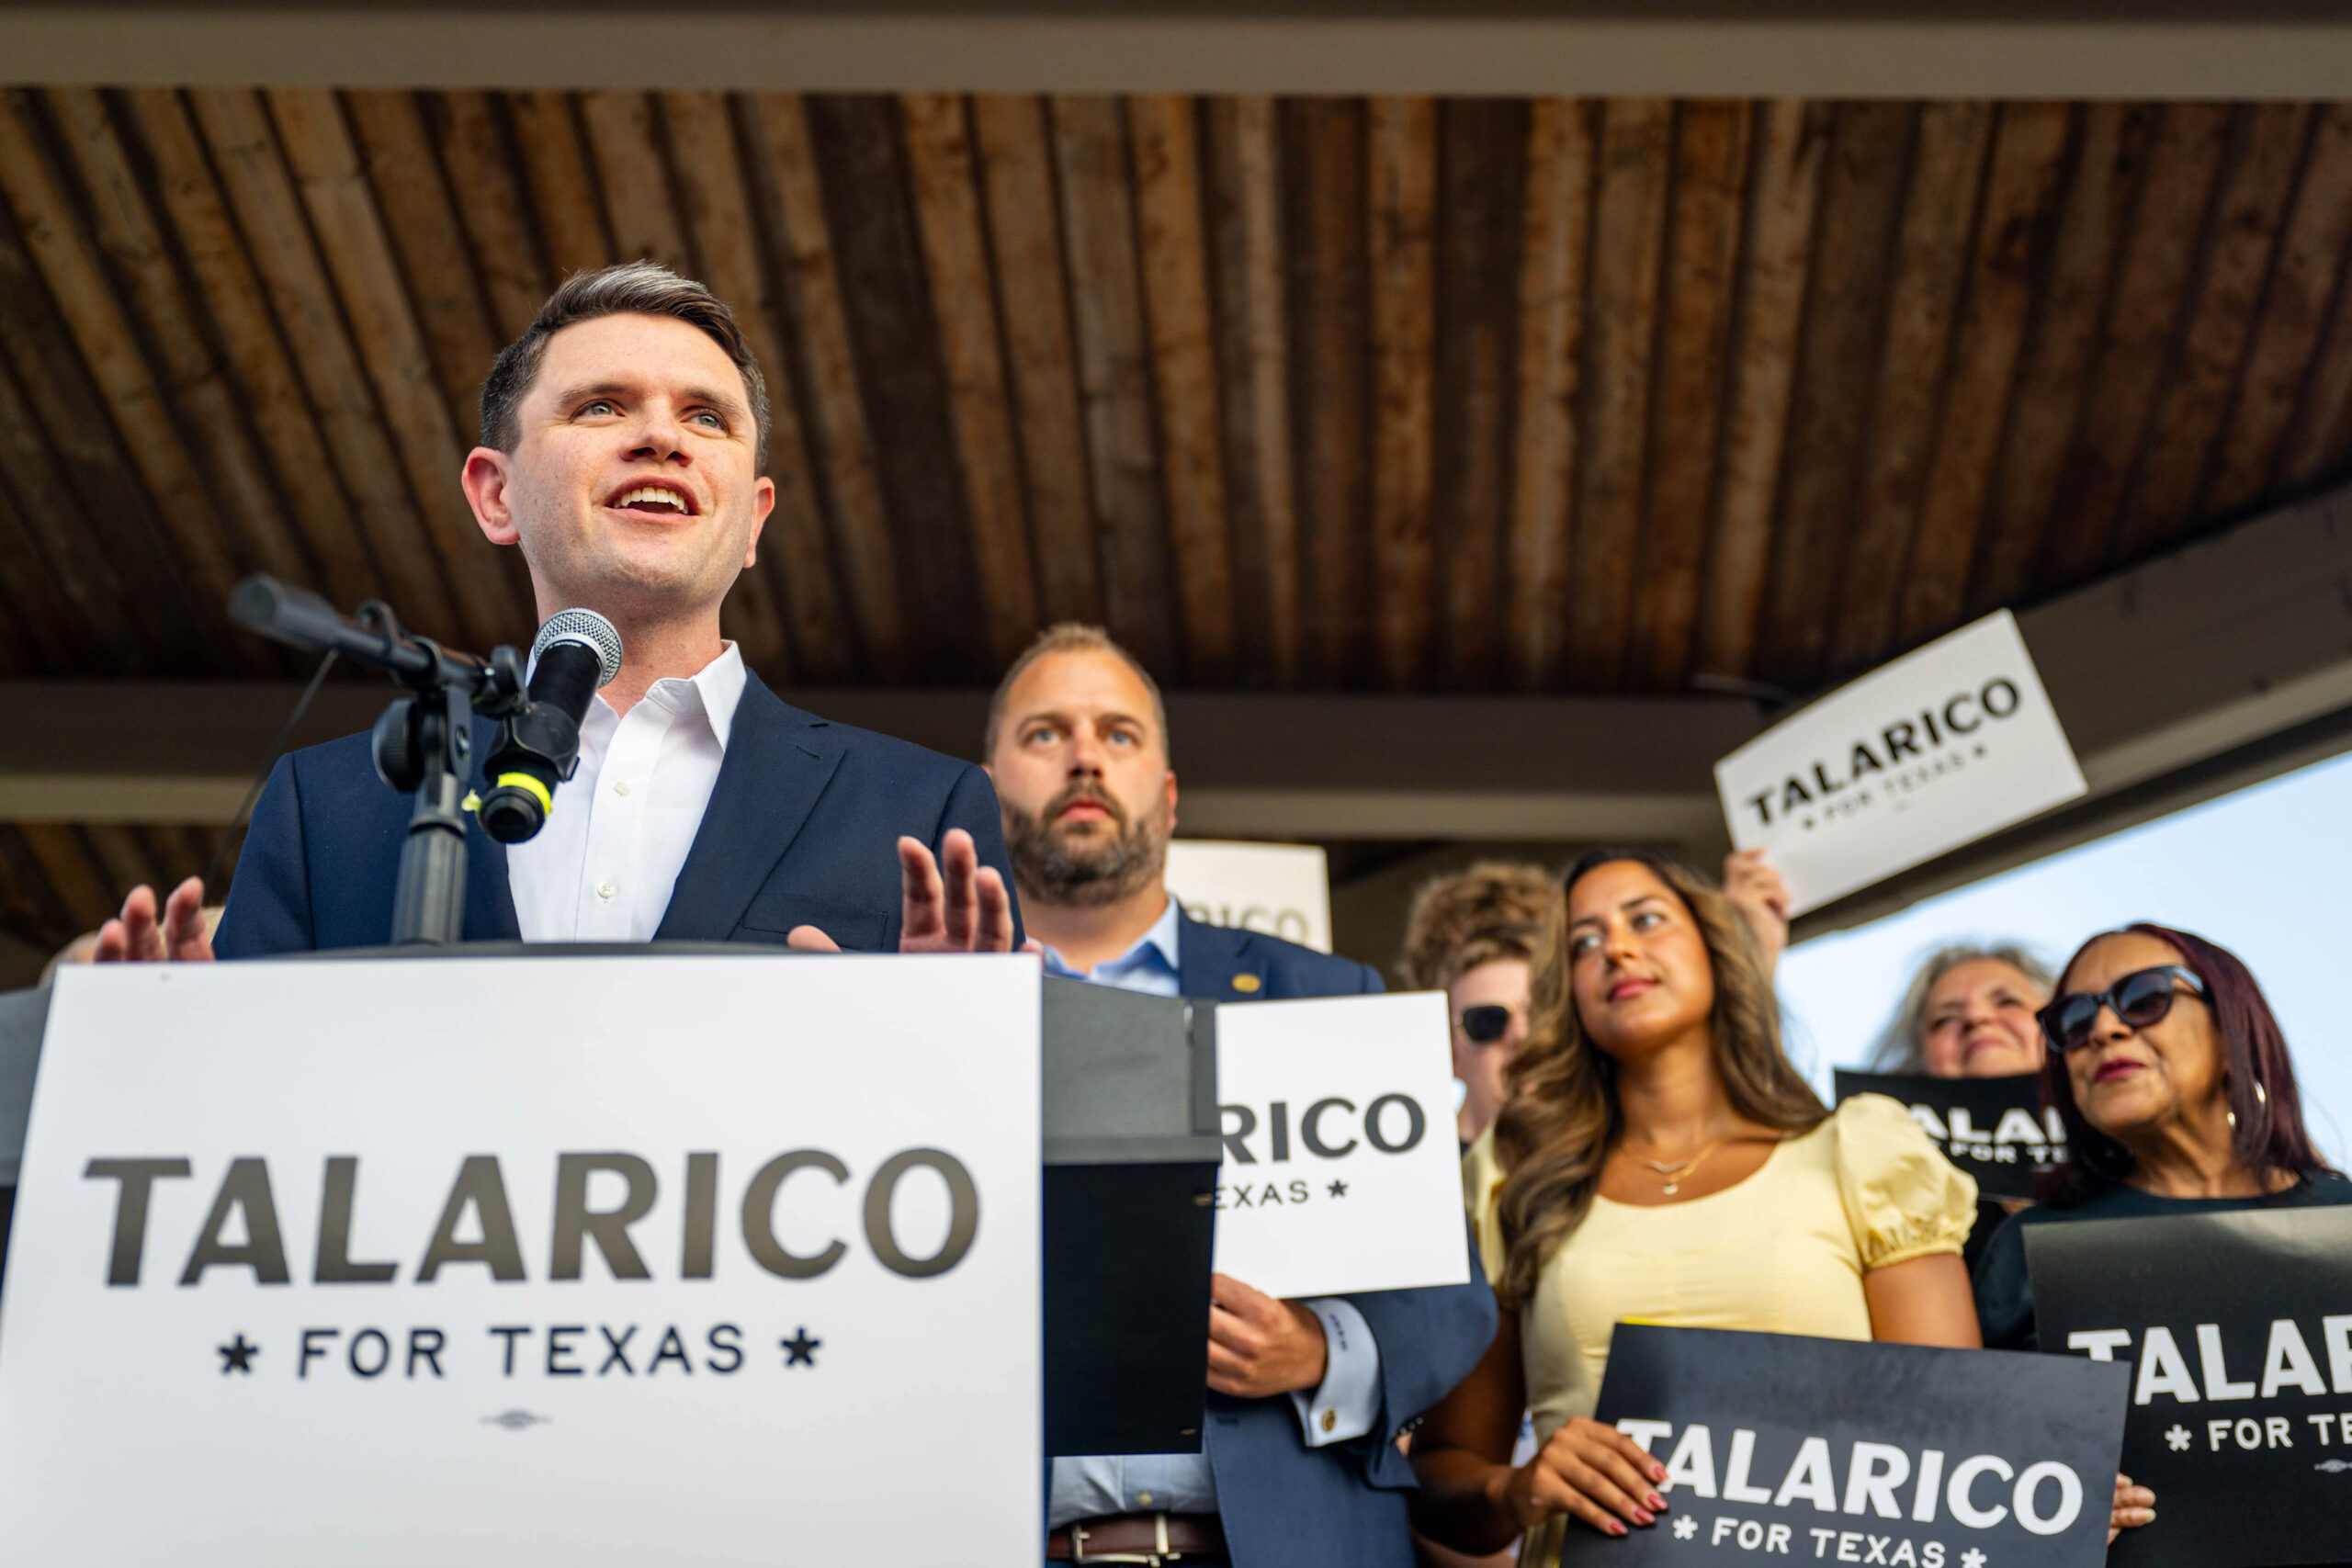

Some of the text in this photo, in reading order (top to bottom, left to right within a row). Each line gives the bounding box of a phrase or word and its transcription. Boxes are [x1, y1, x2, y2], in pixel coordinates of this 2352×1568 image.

[1749, 677, 2020, 826] TALARICO
[1950, 1141, 2018, 1164] FOR
[82, 1146, 980, 1289] TALARICO
[298, 1323, 745, 1380] FOR TEXAS
[2207, 1416, 2293, 1452] FOR
[1615, 1417, 2084, 1535] TALARICO
[1711, 1517, 1946, 1568] FOR TEXAS
